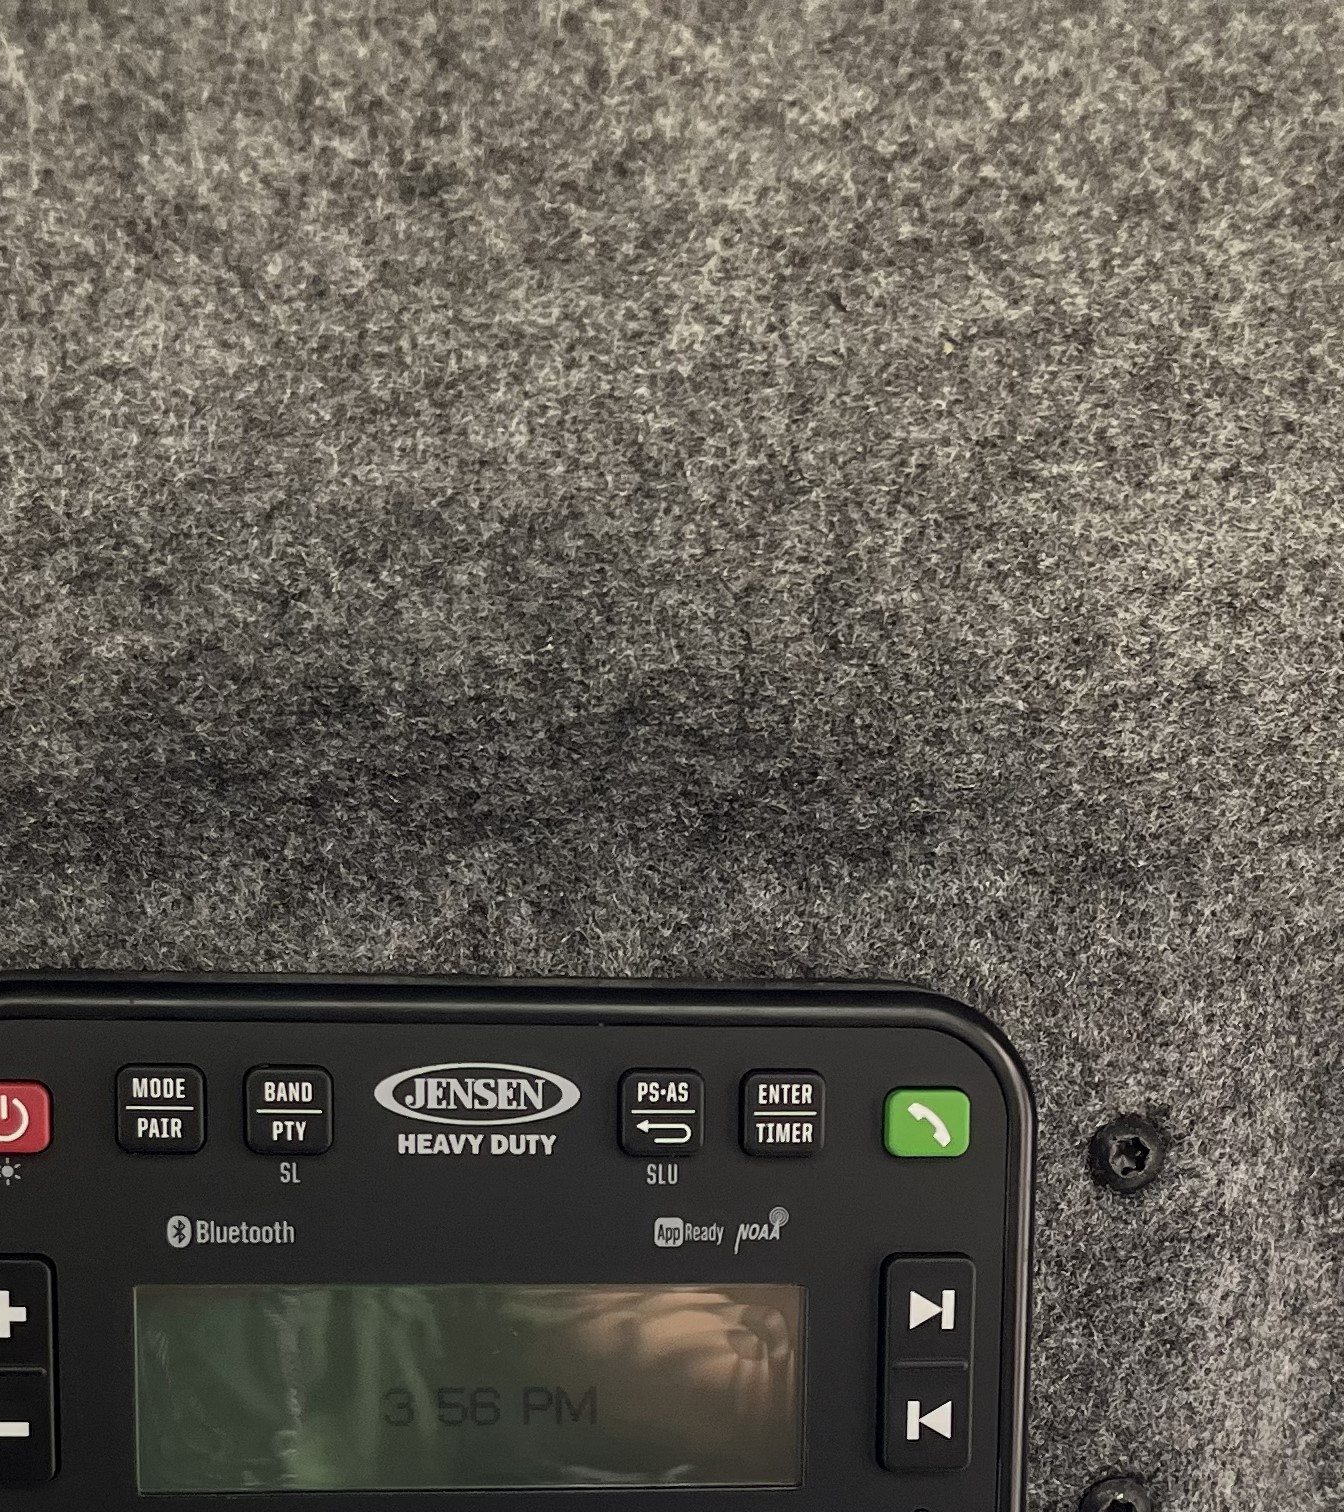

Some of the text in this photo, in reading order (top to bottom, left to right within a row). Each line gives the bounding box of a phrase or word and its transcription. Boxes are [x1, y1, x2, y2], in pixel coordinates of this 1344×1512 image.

[132, 1077, 186, 1099] MODE
[264, 1081, 313, 1103] BAND
[405, 1078, 546, 1110] JENSEN
[758, 1083, 813, 1105] ENTER
[137, 1117, 182, 1139] PAIR
[272, 1120, 307, 1141] PTY
[755, 1122, 813, 1144] TIMER
[397, 1133, 557, 1156] HEAVY DUTY
[279, 1161, 301, 1184] SL
[646, 1163, 678, 1185] SLU
[195, 1219, 295, 1244] Bluetooth
[734, 1222, 782, 1255] NOAA
[522, 1386, 598, 1426] PM
